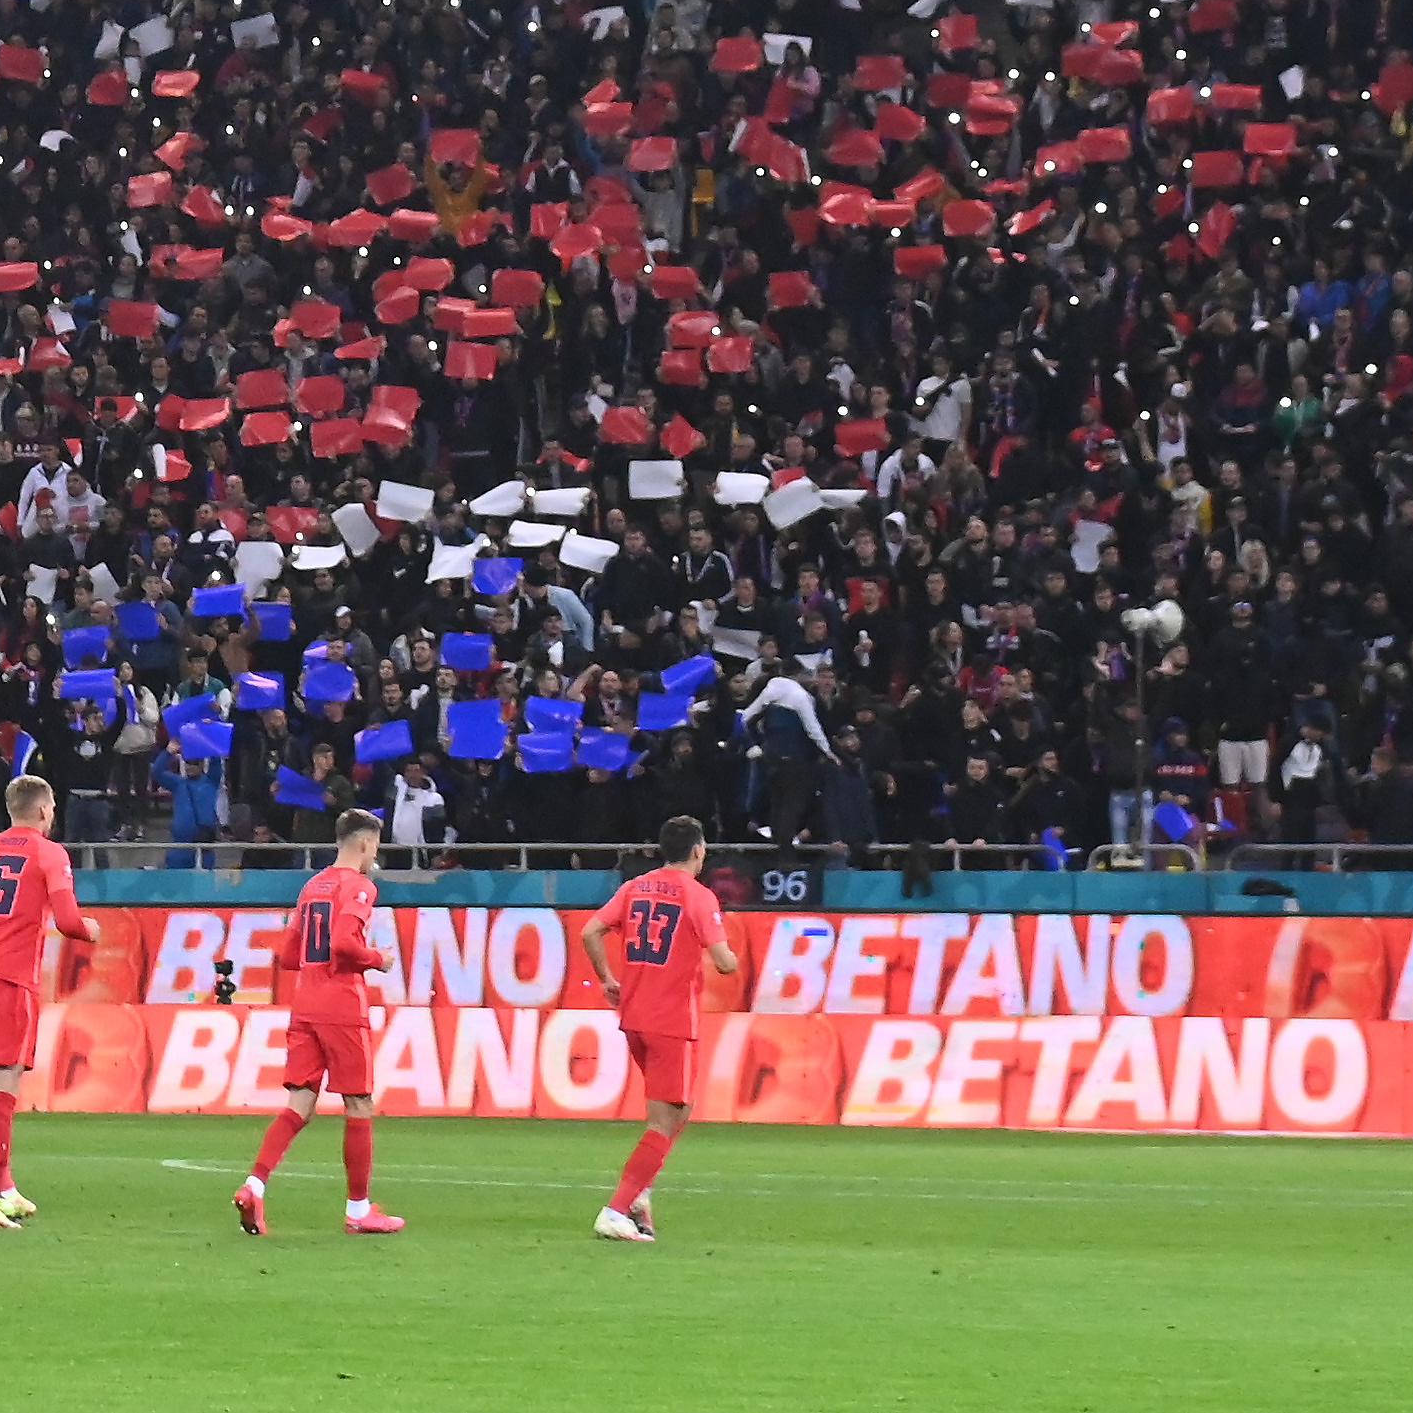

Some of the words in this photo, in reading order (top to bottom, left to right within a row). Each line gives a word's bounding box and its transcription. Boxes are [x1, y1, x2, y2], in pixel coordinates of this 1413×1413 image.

[762, 870, 809, 901] 96
[626, 900, 682, 966] 33
[750, 913, 1194, 1017] BETANO
[840, 1018, 1370, 1127] BETANO
